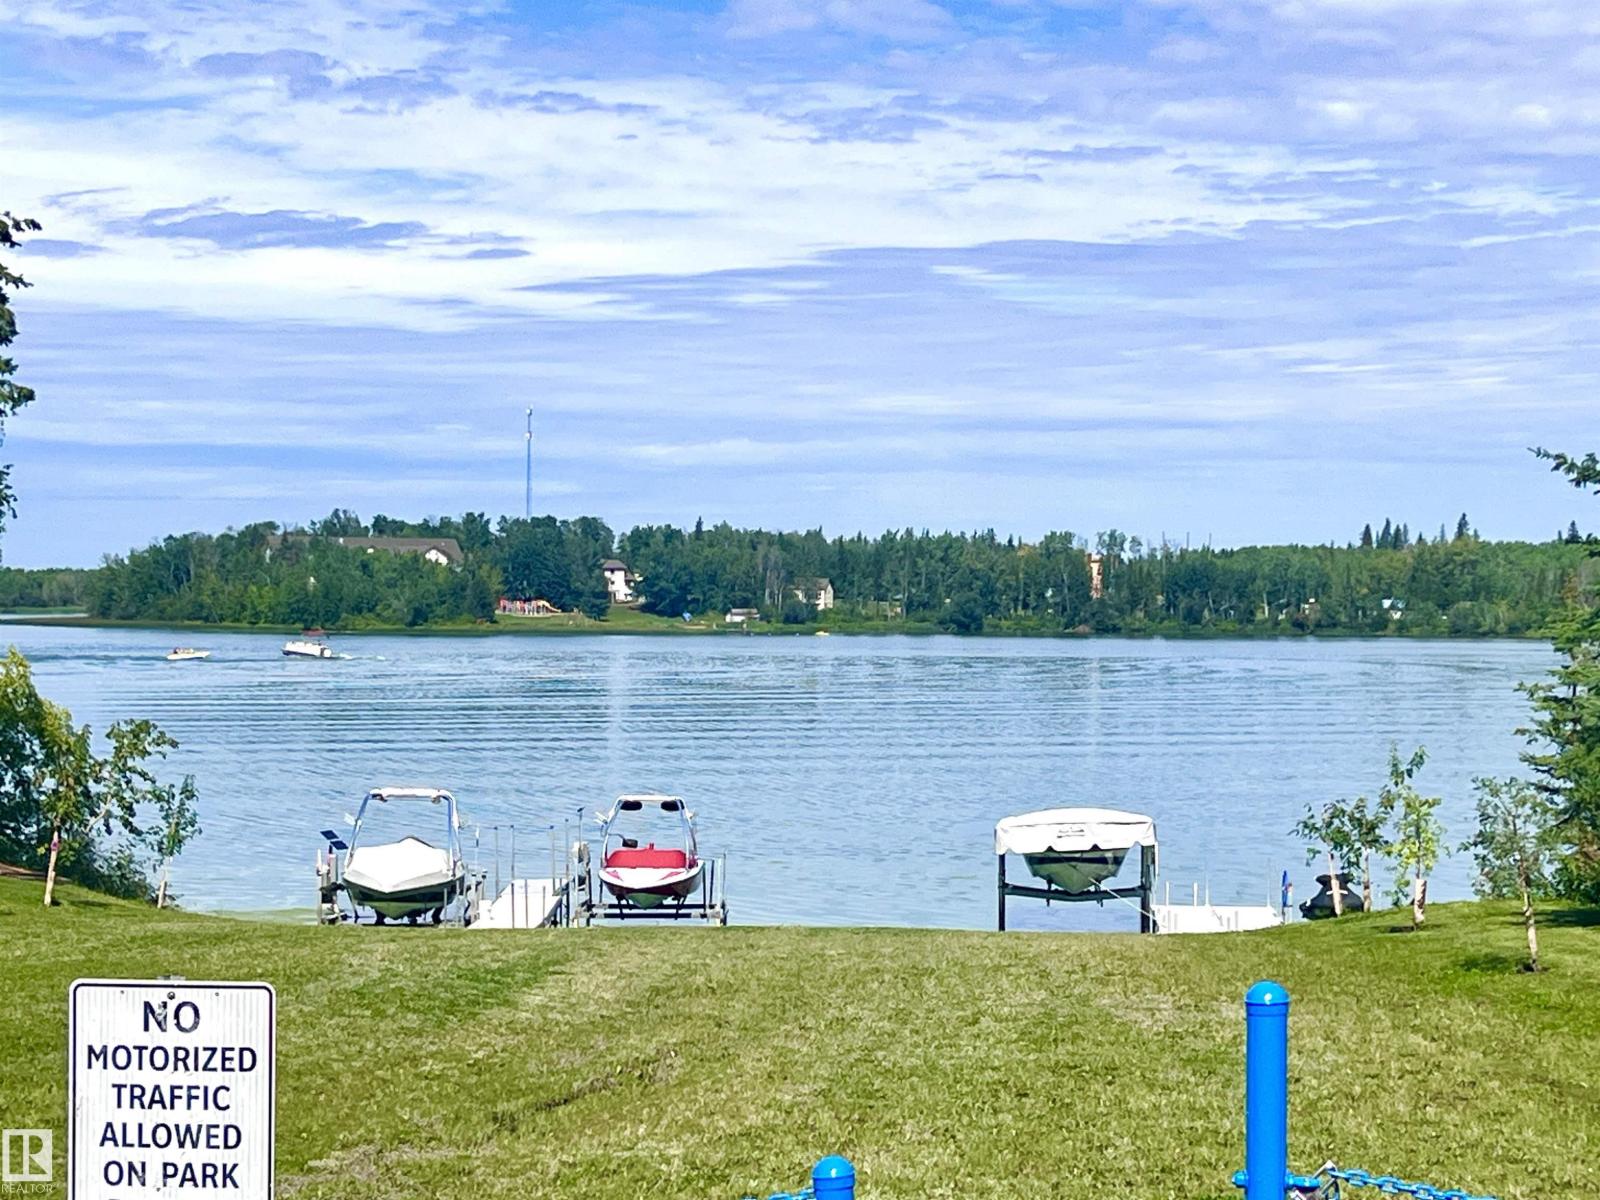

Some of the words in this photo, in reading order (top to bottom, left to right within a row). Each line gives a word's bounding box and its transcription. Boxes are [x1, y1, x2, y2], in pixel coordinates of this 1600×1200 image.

[143, 1000, 201, 1033] NO
[87, 1044, 257, 1072] MOTORIZED
[112, 1084, 231, 1111] TRAFFIC
[99, 1122, 242, 1150] ALLOWED
[104, 1161, 147, 1187] ON
[162, 1162, 240, 1188] PARK
